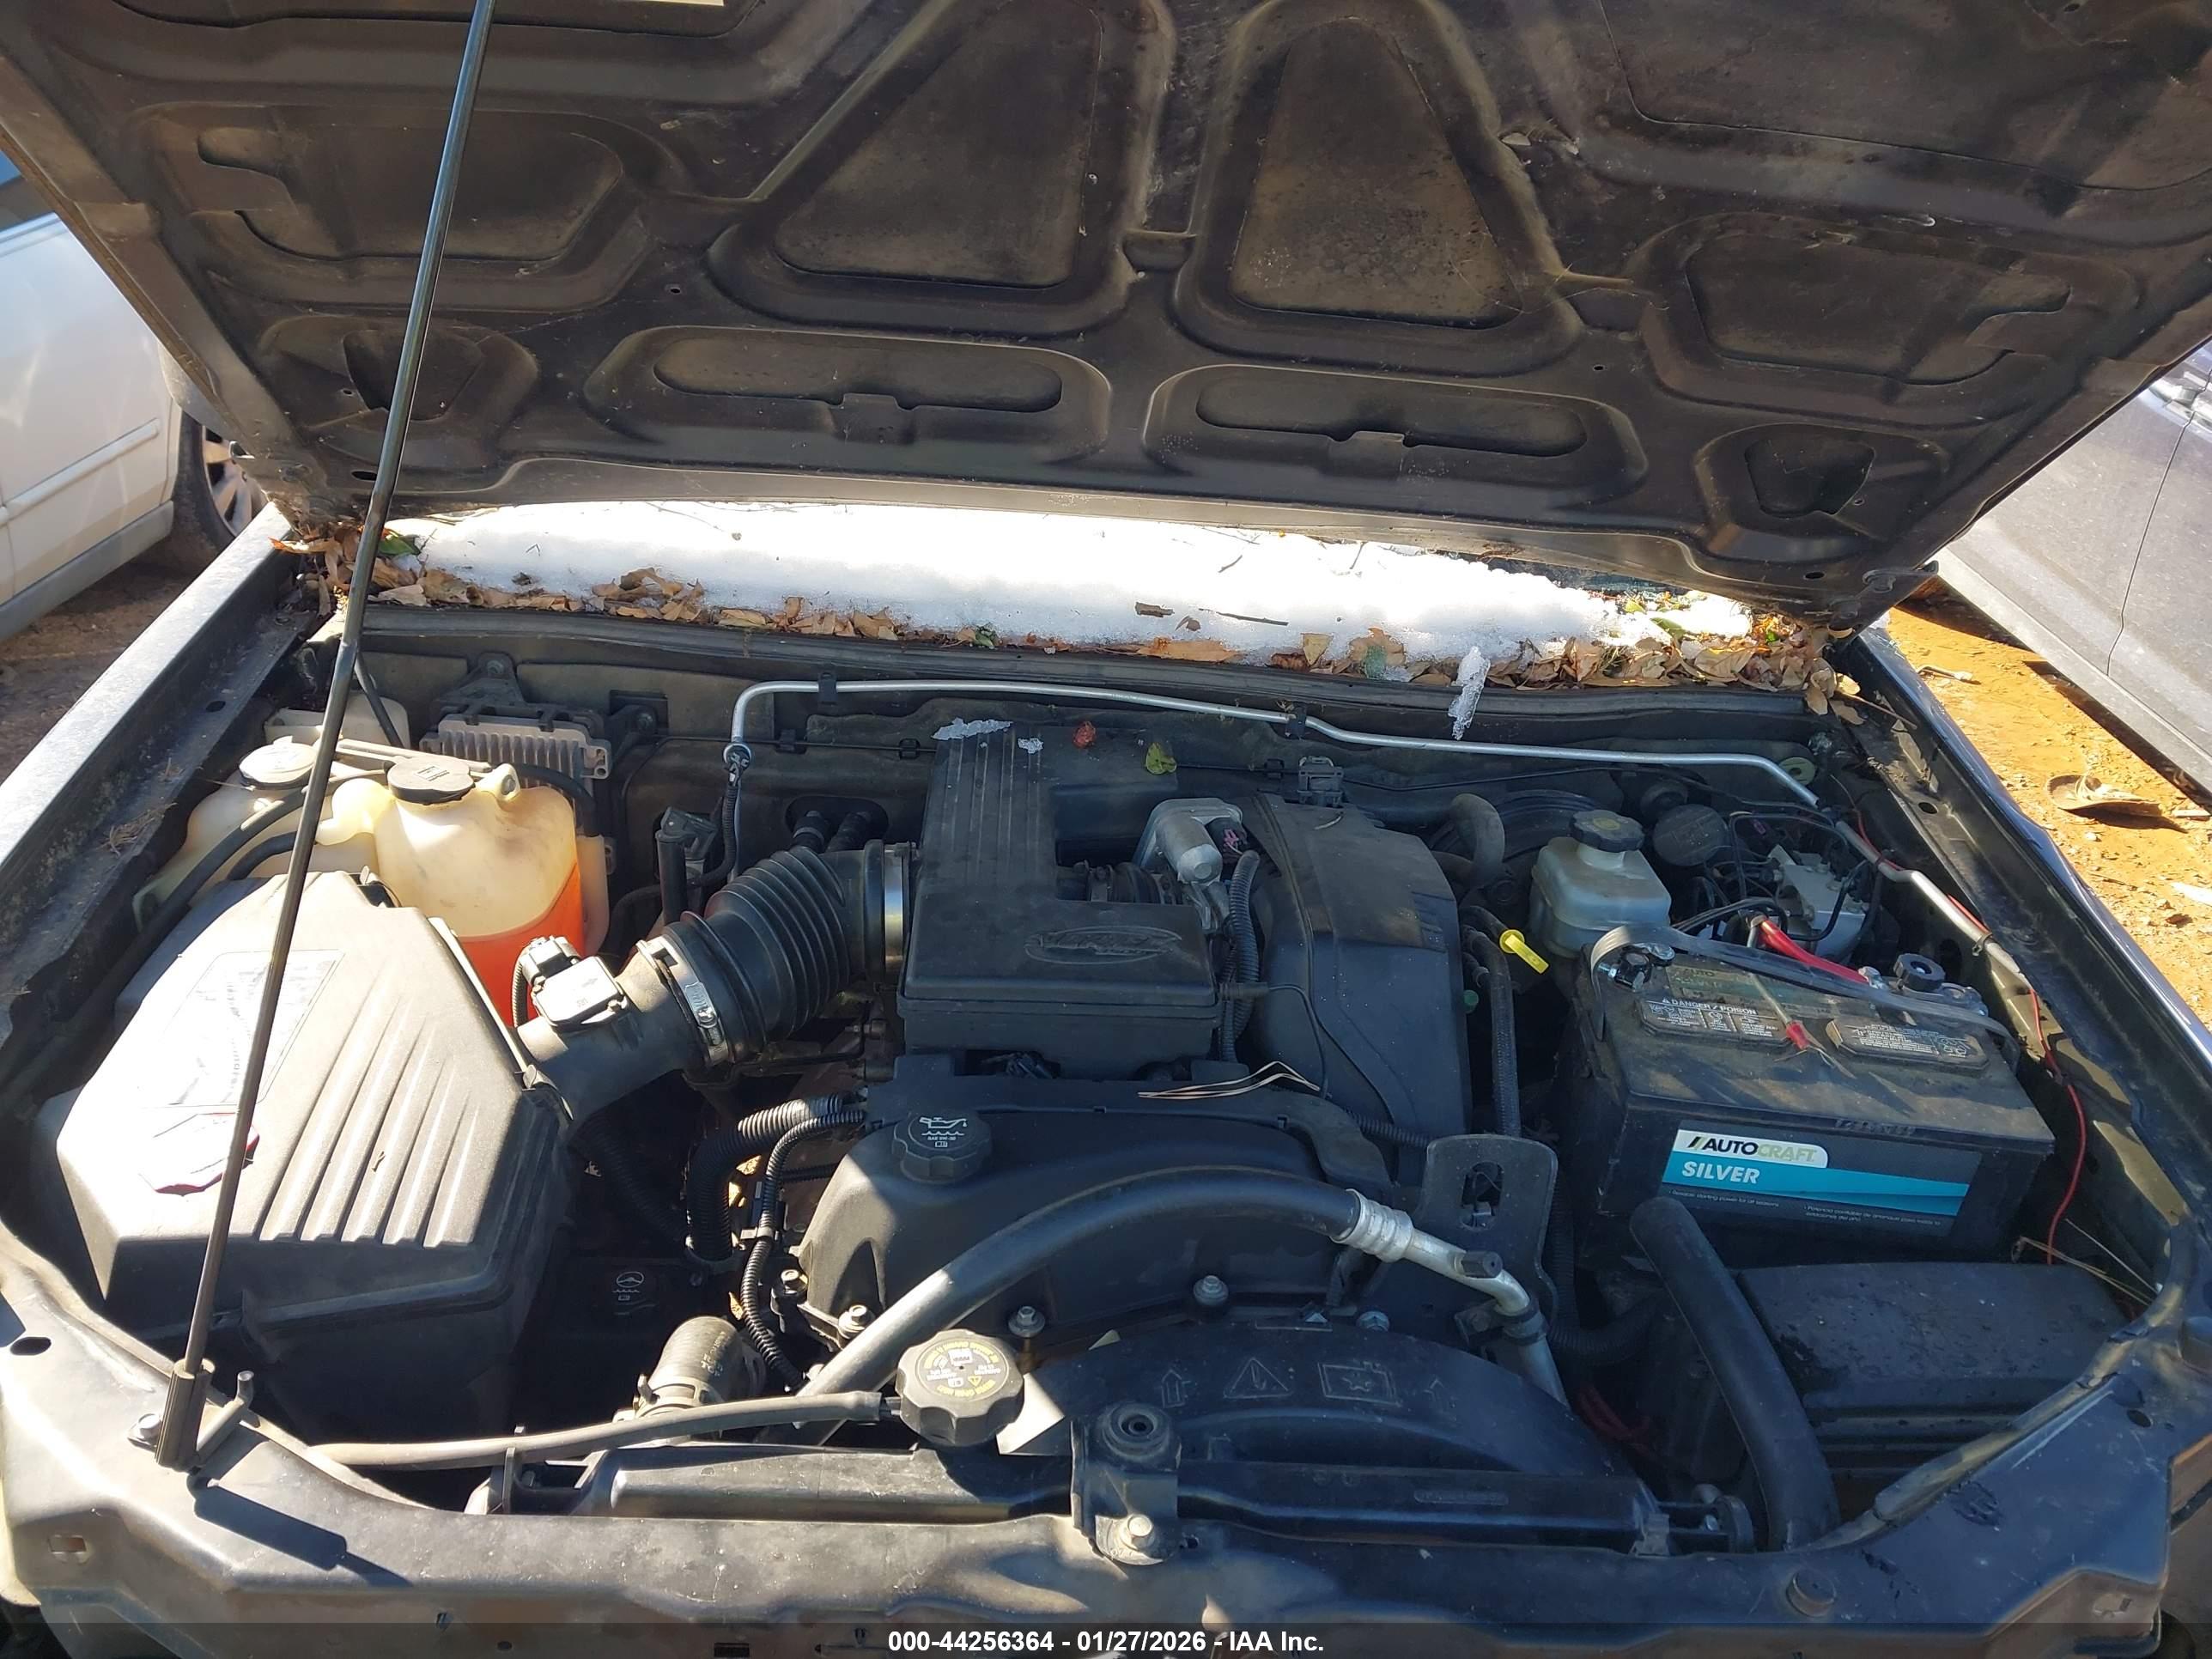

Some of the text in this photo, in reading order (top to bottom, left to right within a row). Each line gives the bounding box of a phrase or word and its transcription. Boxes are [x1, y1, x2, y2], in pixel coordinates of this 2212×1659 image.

[1671, 999, 1711, 1009] DANGER
[1720, 1006, 1758, 1014] POISON
[1702, 1138, 1817, 1163] AUTOCRAFT
[1681, 1161, 1760, 1184] SILVER
